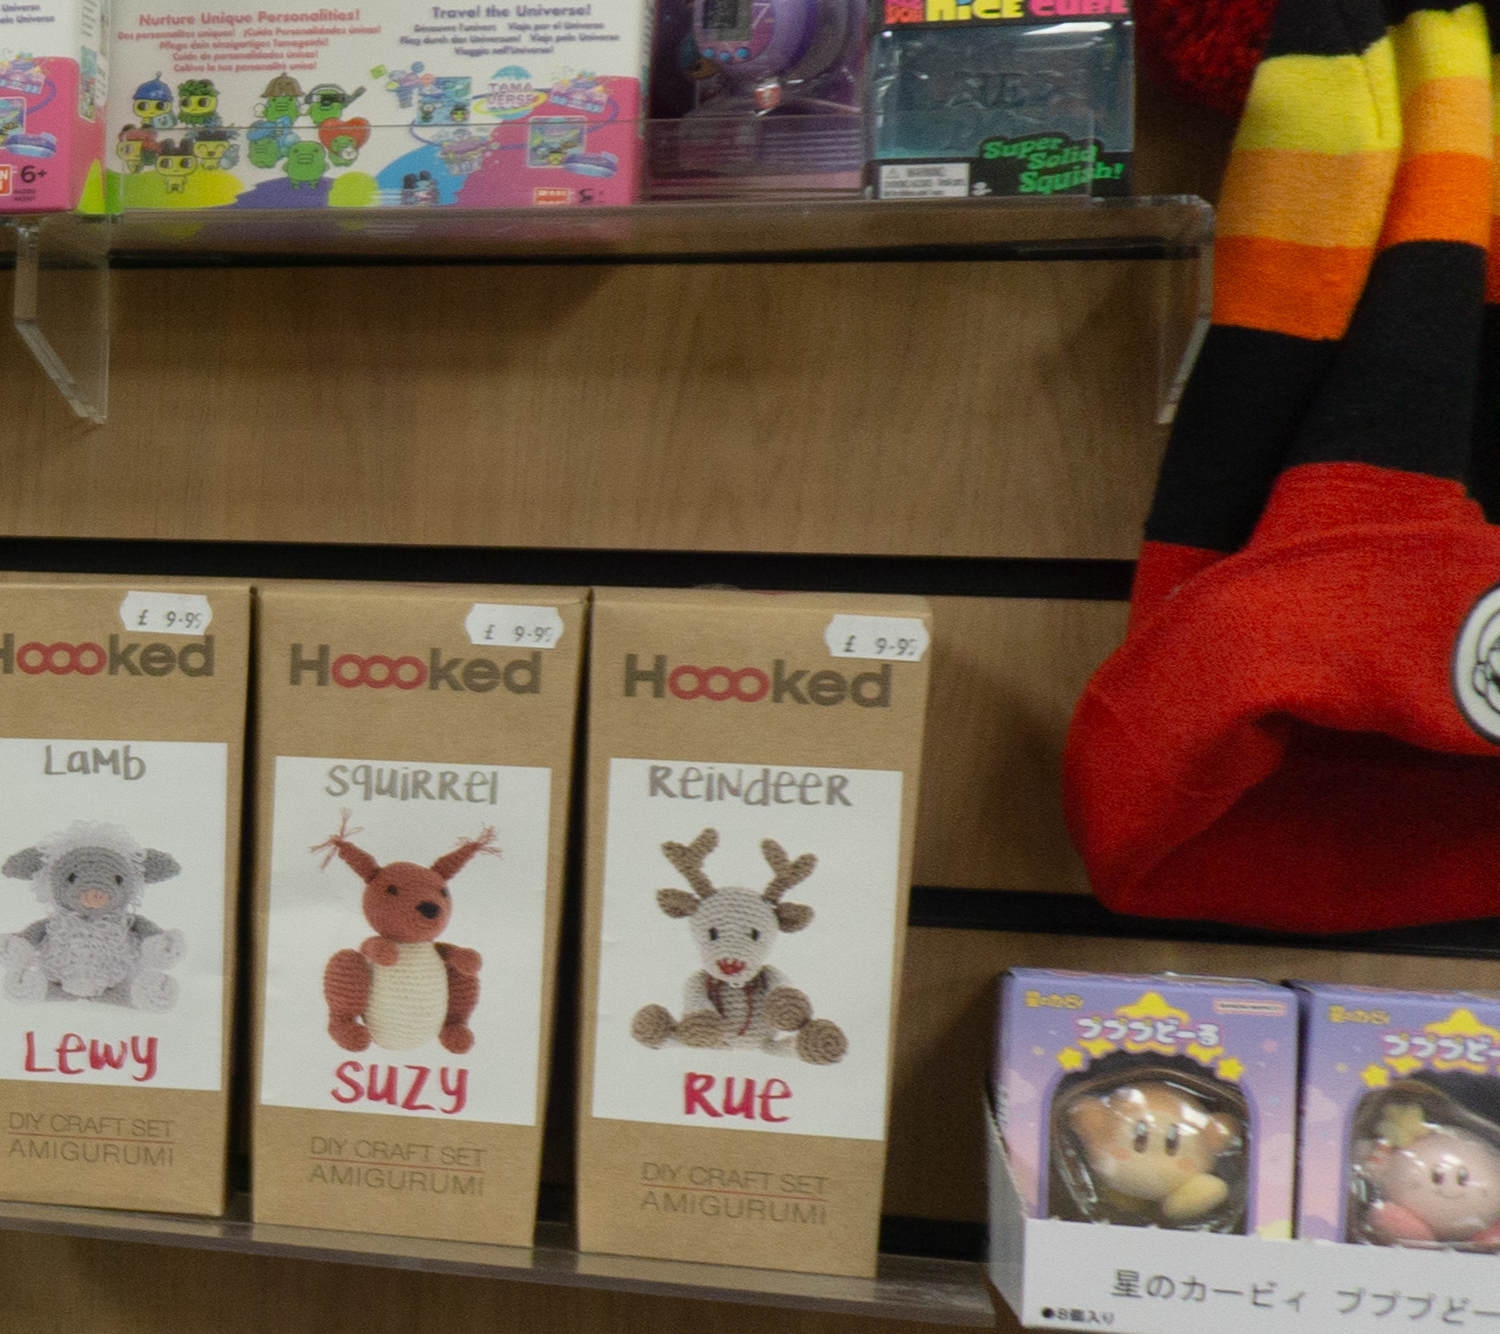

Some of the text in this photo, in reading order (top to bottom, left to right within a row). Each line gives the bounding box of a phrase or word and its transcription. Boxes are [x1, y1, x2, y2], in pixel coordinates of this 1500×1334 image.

[311, 1135, 489, 1167] DIY CRAFT SET
[310, 1163, 485, 1197] AMIGURUMI
